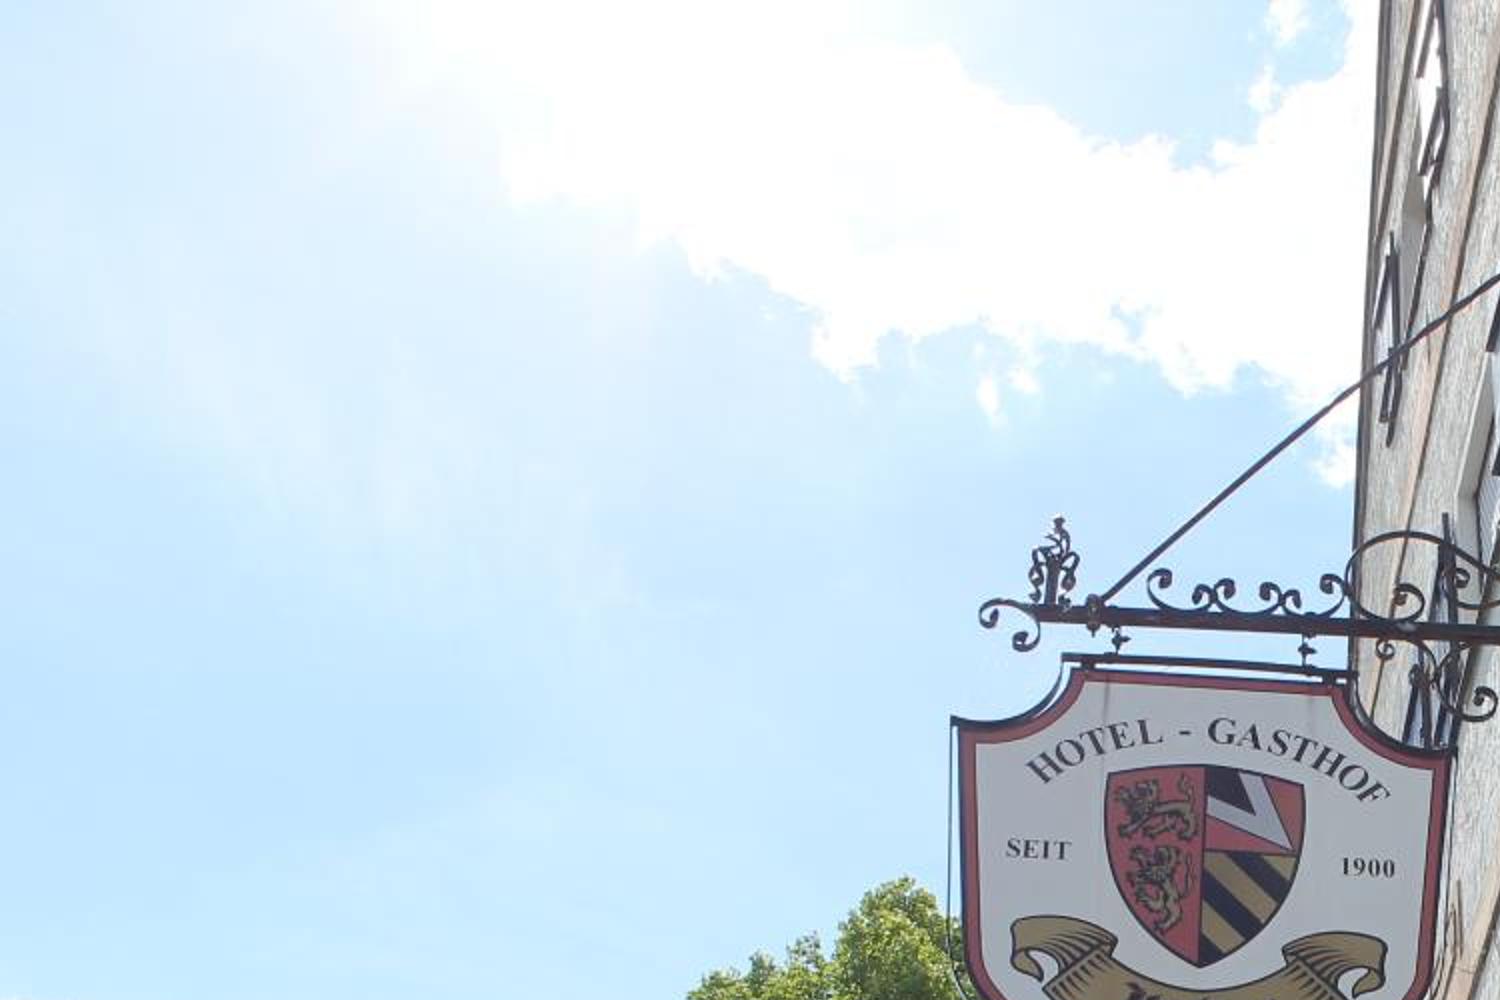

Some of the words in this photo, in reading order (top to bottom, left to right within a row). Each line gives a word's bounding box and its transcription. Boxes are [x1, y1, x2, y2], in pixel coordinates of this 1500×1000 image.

[1023, 718, 1164, 785] HOTEL
[1206, 716, 1391, 805] GASTHOF
[1005, 837, 1073, 862] SEIT
[1341, 855, 1396, 878] 1900
